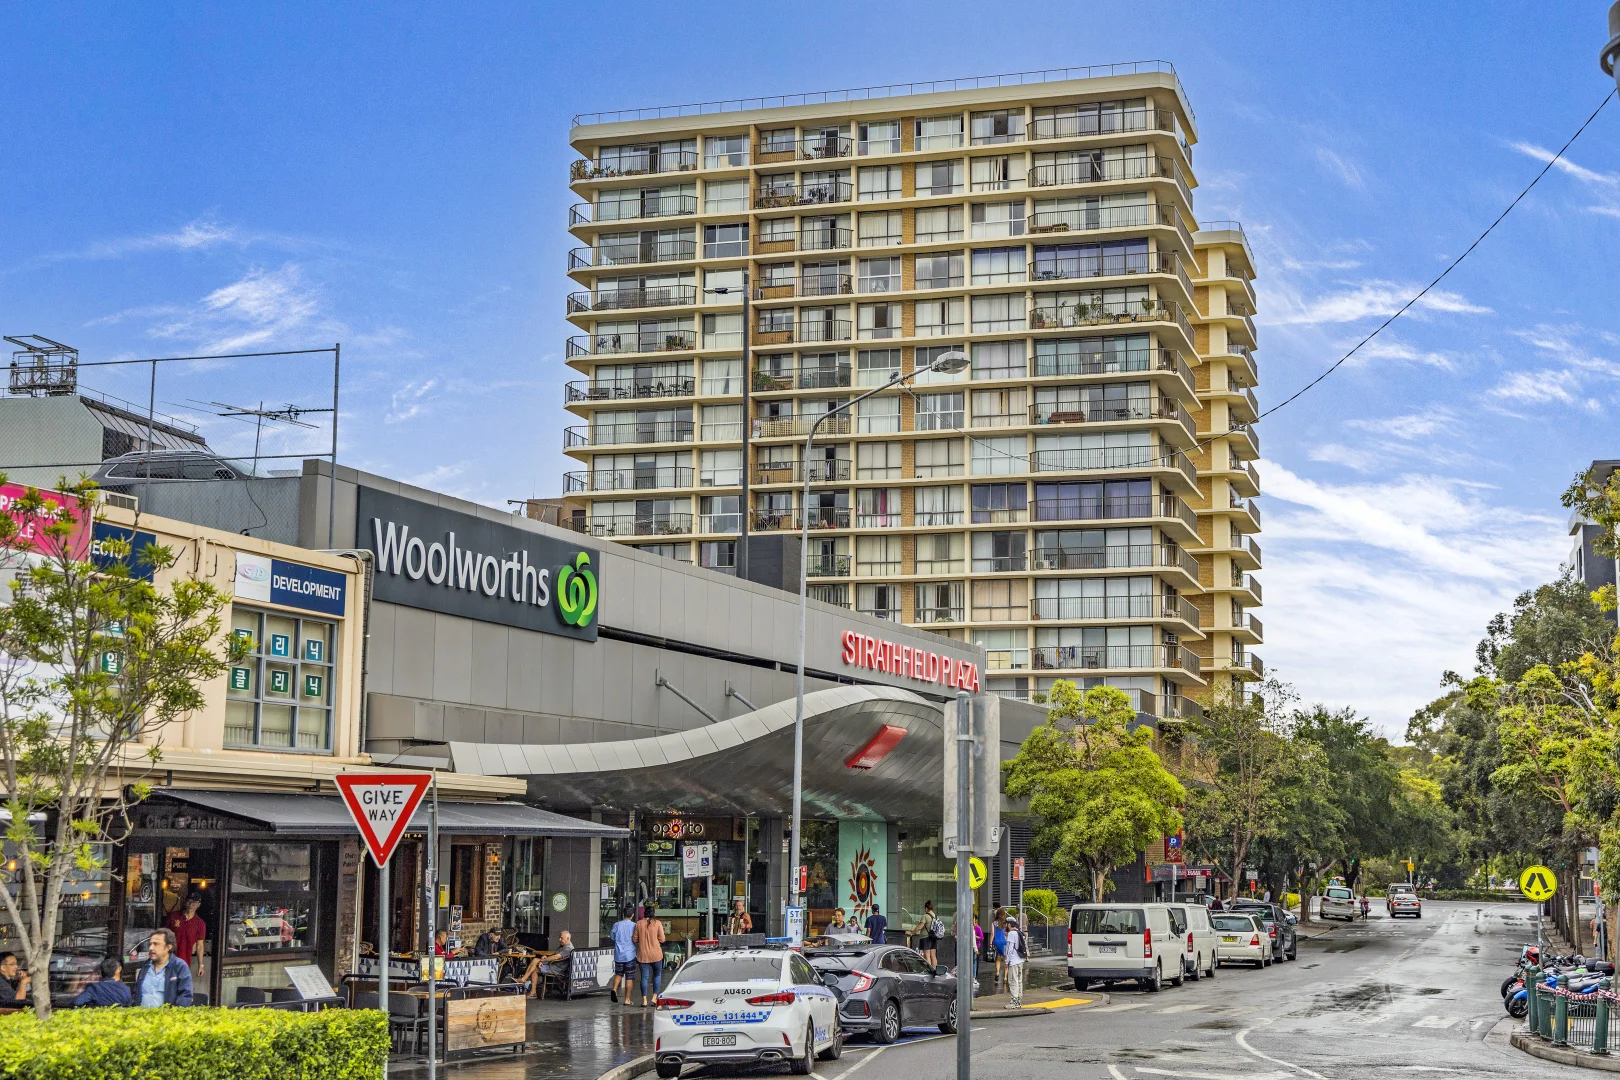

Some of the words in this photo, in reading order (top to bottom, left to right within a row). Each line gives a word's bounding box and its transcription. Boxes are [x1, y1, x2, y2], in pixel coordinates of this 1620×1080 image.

[371, 517, 550, 607] Woolworths
[273, 574, 341, 600] DEVELOPMENT
[842, 630, 938, 682] STRATHFIELD
[939, 655, 980, 692] PLAZA
[362, 790, 403, 805] GIVE
[368, 809, 397, 821] WAY
[652, 821, 704, 837] oporto
[702, 846, 708, 854] P
[685, 1013, 718, 1022] Police
[724, 1012, 738, 1020] 131
[740, 1011, 756, 1020] 444
